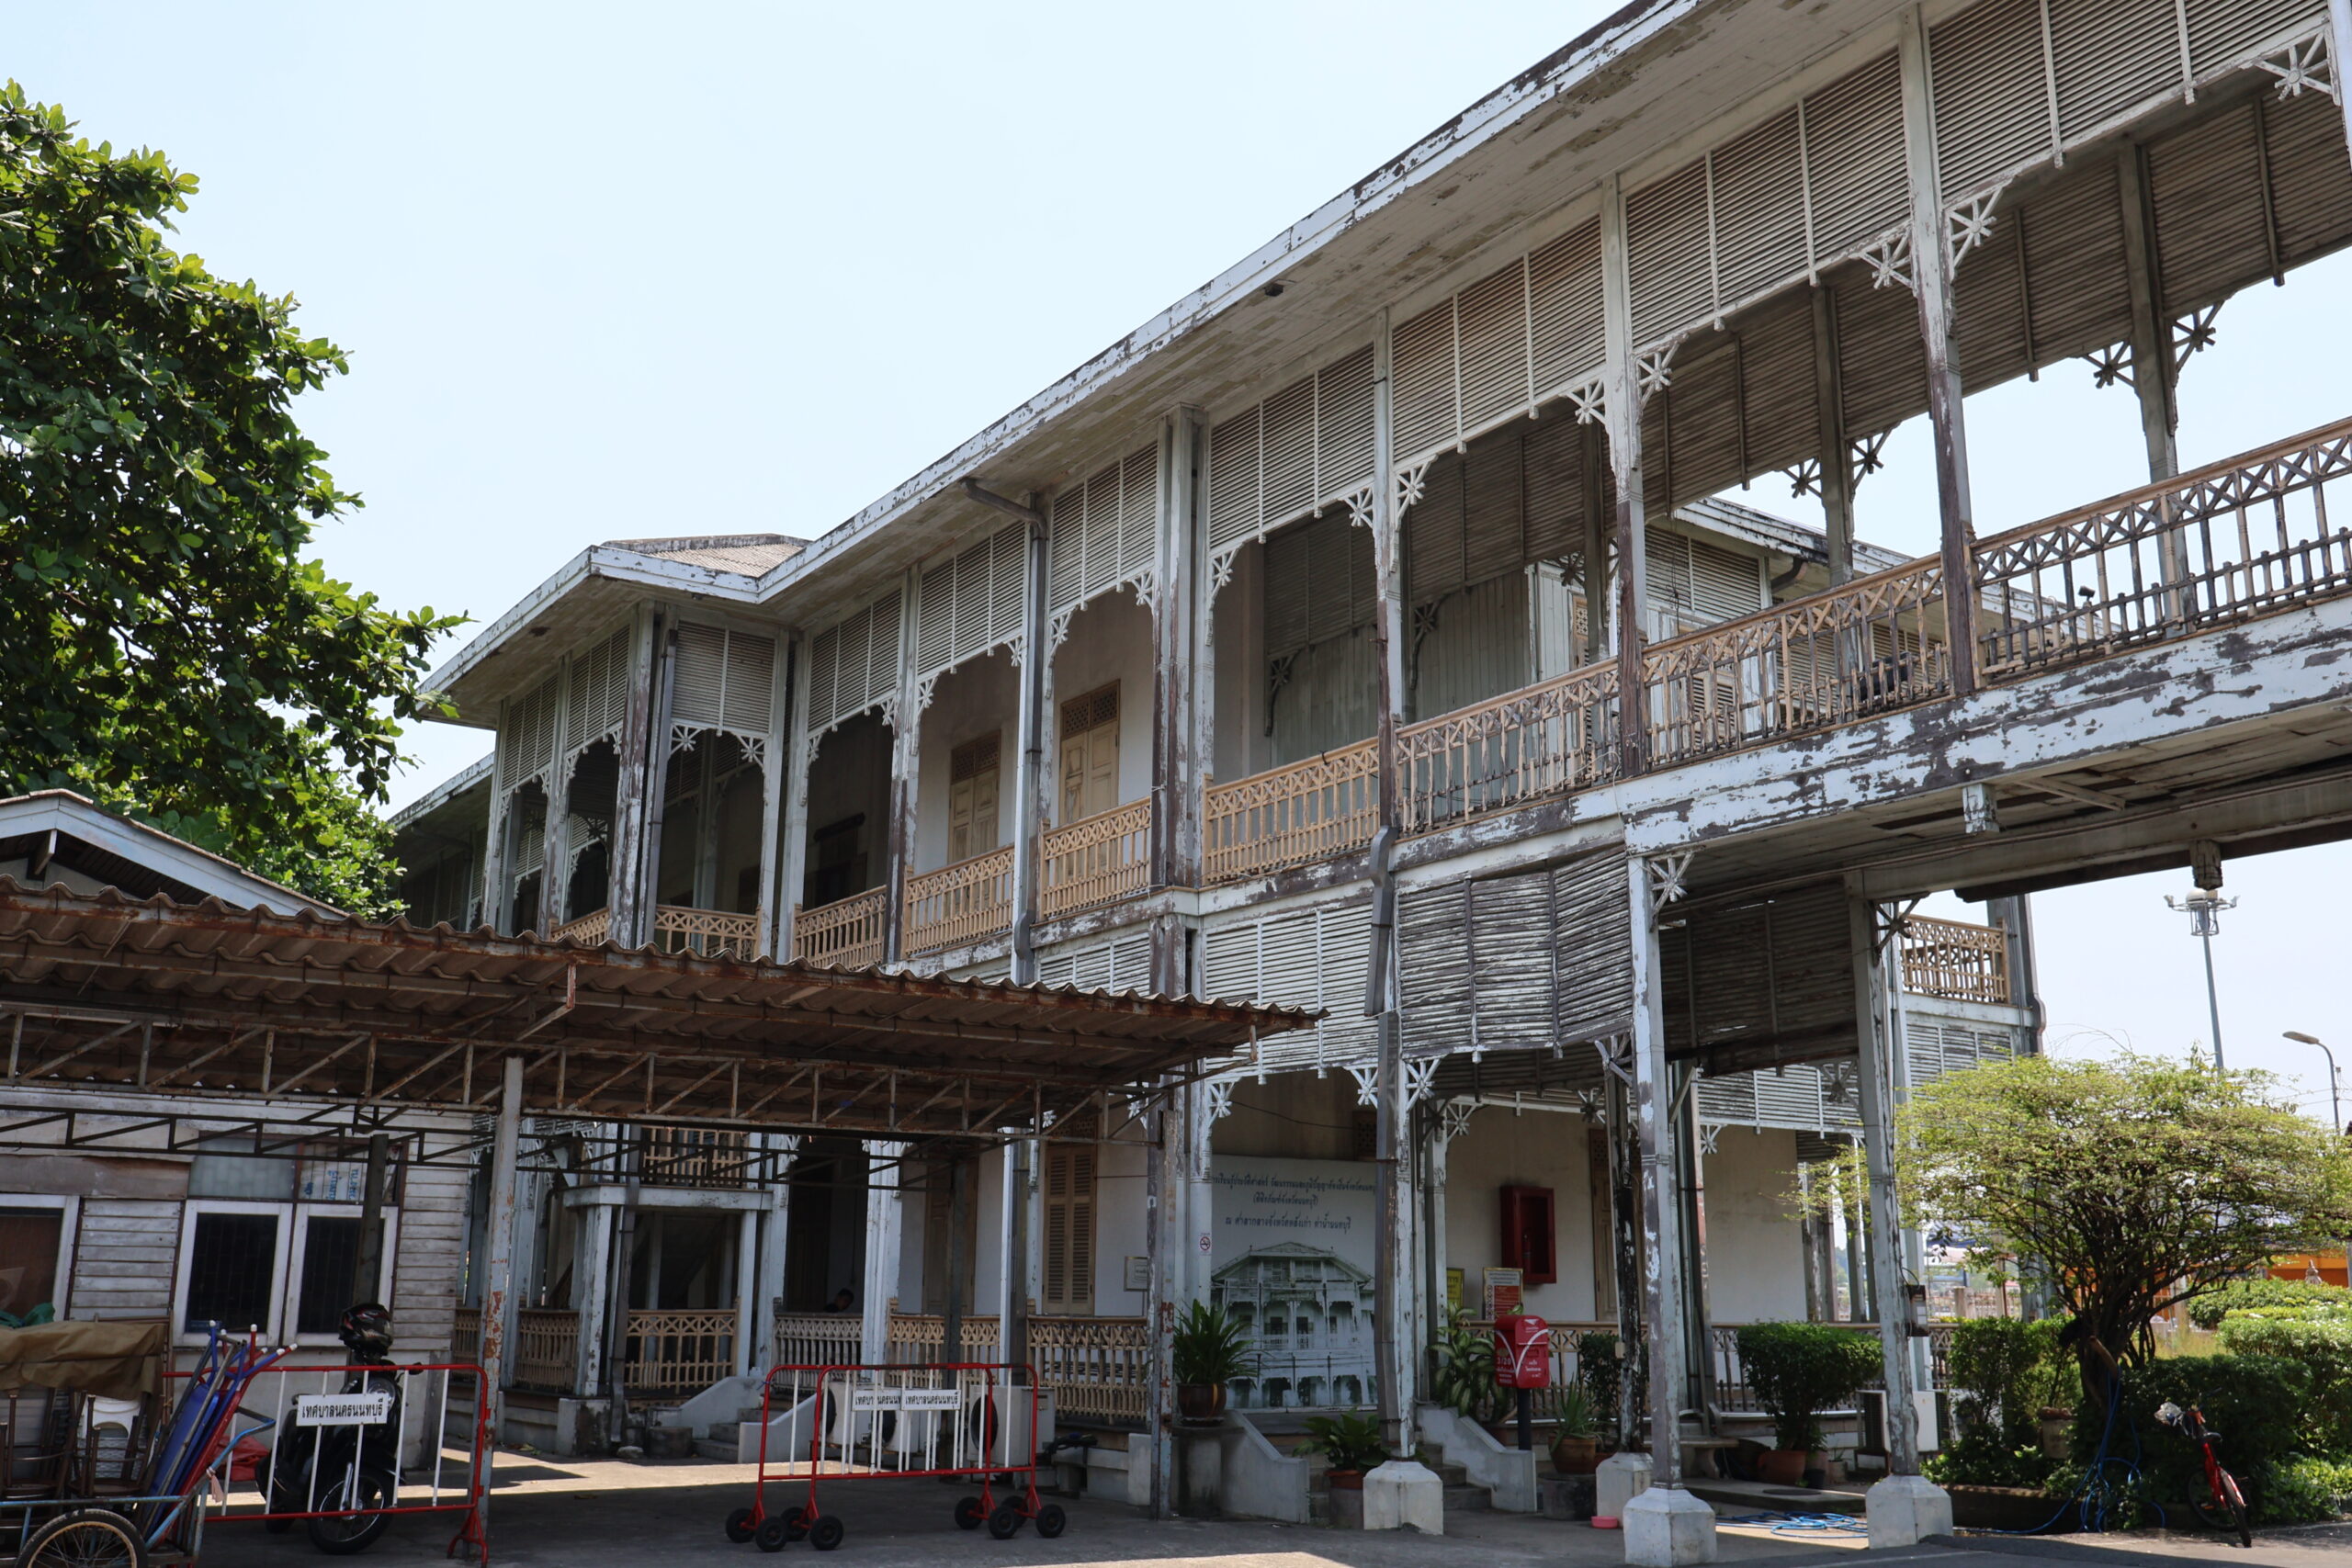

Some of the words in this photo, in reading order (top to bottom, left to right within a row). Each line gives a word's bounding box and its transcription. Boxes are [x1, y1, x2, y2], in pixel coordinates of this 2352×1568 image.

[301, 1397, 383, 1423] เทศบาลนครนนทบุรี
[905, 1391, 958, 1409] เทศบาลนครนนทบุรี
